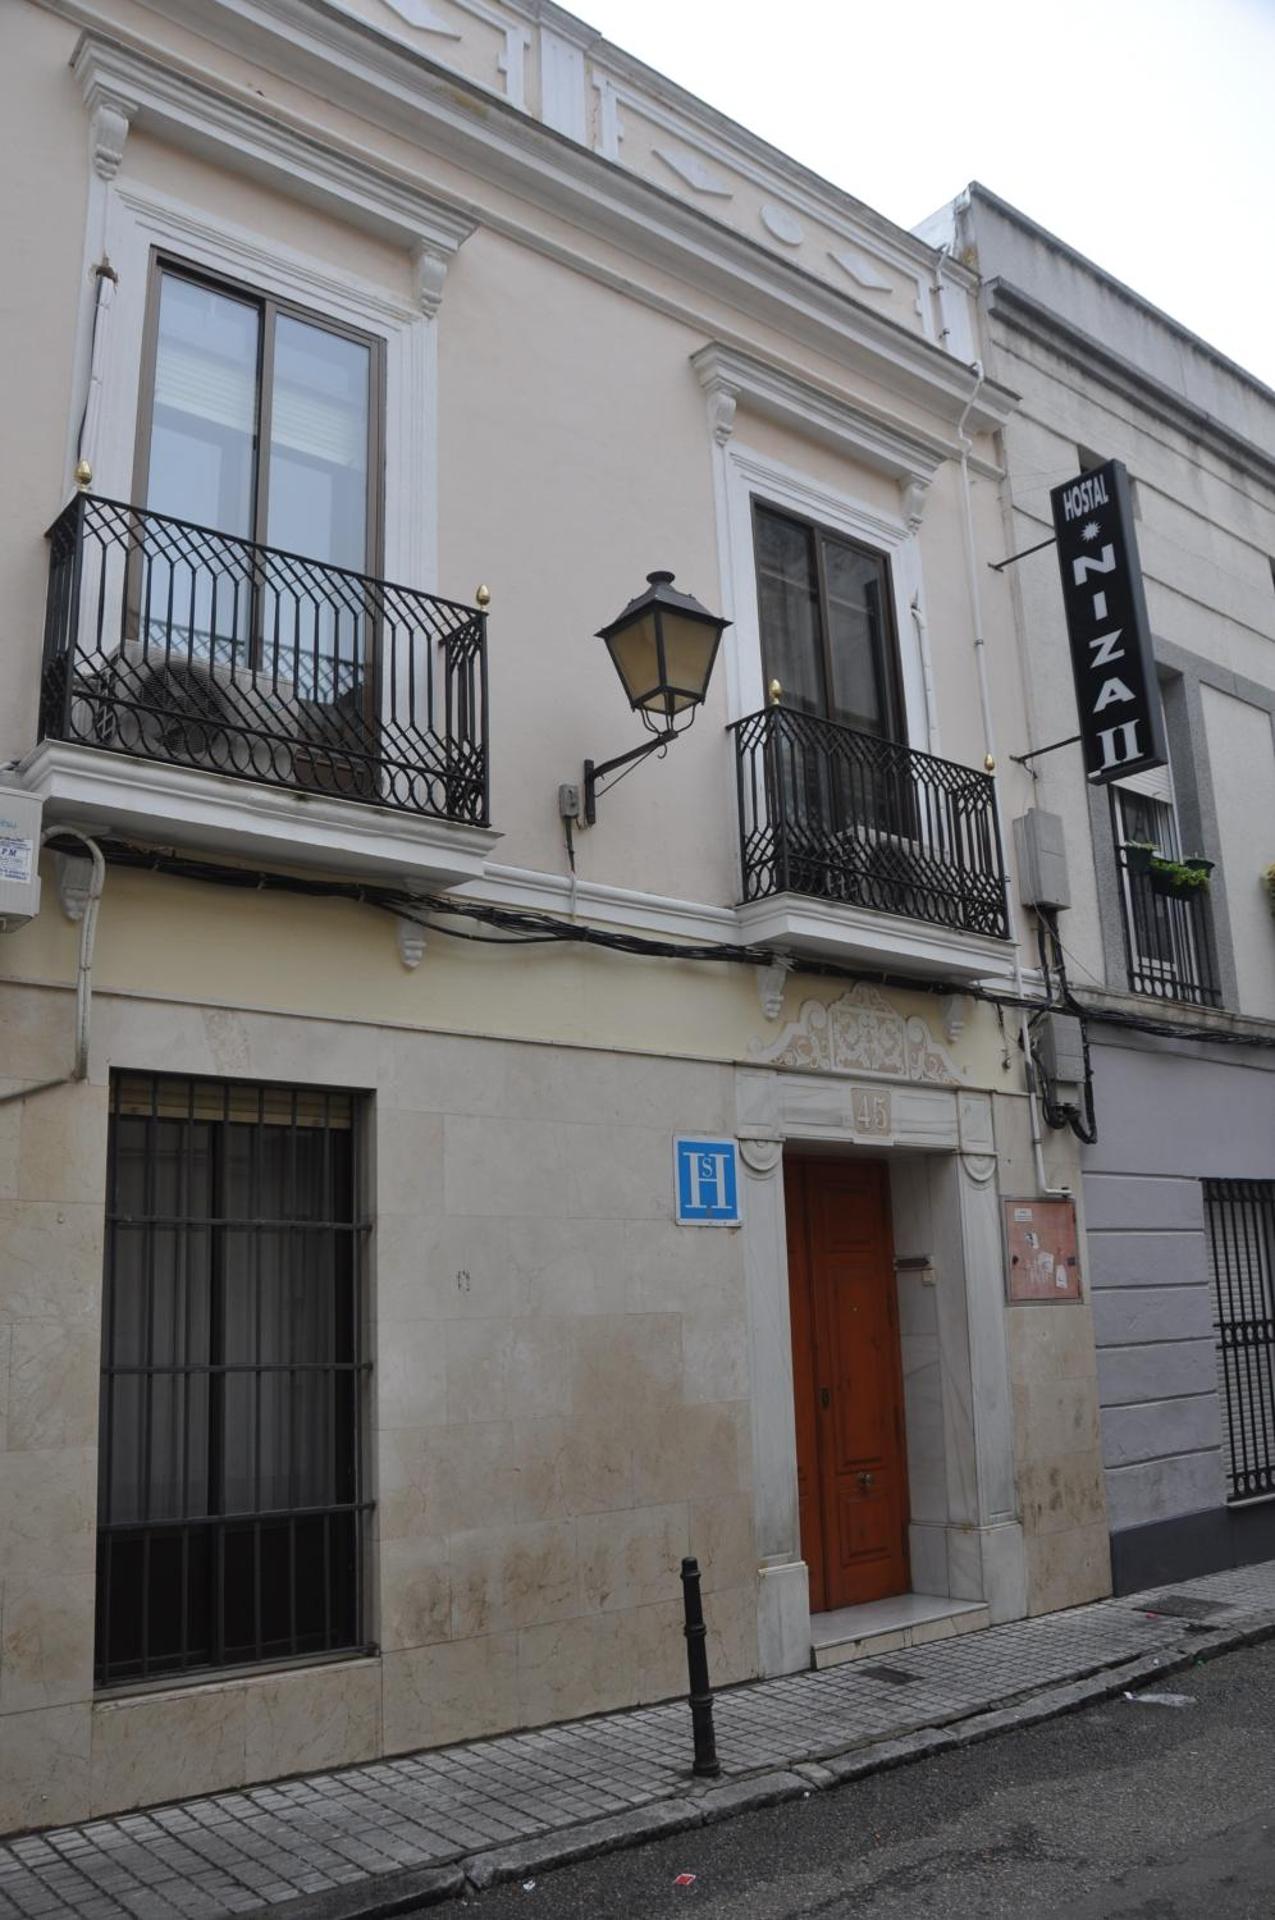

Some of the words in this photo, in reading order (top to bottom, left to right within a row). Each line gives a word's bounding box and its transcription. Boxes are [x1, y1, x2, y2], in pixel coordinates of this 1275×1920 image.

[1063, 474, 1109, 521] HOSTAL
[1072, 543, 1136, 714] NIZA
[1096, 718, 1145, 770] II
[857, 1095, 888, 1129] 45
